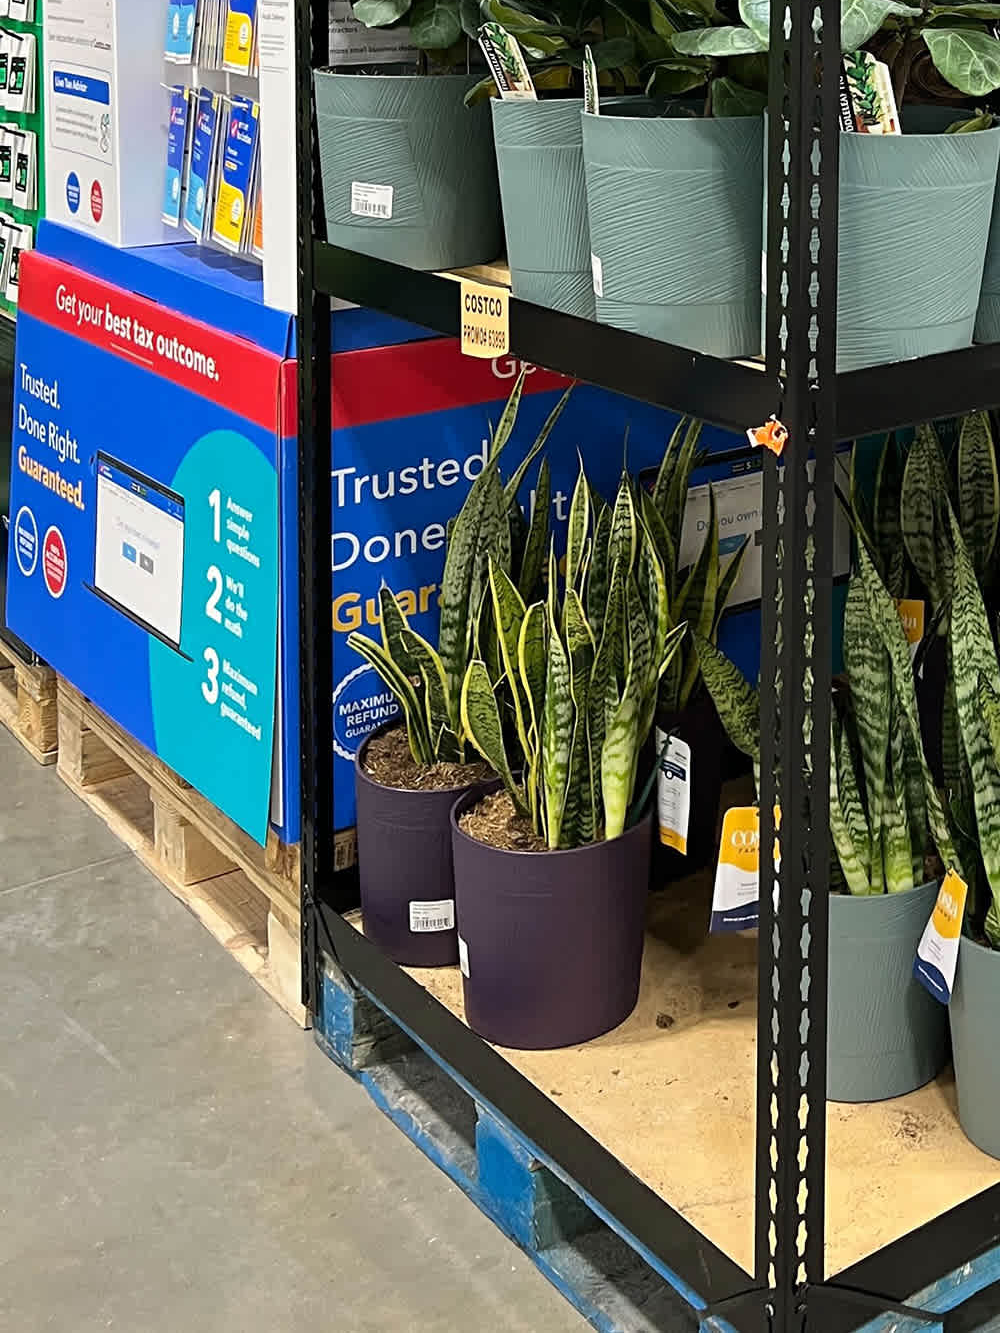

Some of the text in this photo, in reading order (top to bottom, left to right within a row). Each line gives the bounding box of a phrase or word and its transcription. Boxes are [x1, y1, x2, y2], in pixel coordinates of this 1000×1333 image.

[464, 293, 502, 317] COSTCO
[56, 284, 220, 382] Get your best tax outcome.
[20, 363, 61, 410] Trusted.
[18, 403, 81, 465] Done Right.
[18, 445, 86, 511] Guaranteed.
[208, 488, 221, 543] 1
[226, 496, 253, 522] Answer
[226, 517, 250, 542] simple
[226, 538, 260, 568] questions
[331, 522, 446, 572] Done
[205, 564, 223, 624] 2
[225, 595, 249, 622] do the
[202, 647, 220, 705] 3
[222, 658, 258, 697] Maximum
[220, 701, 262, 742] guaranteed
[340, 692, 397, 716] MAXIMU
[346, 704, 399, 727] REFUND
